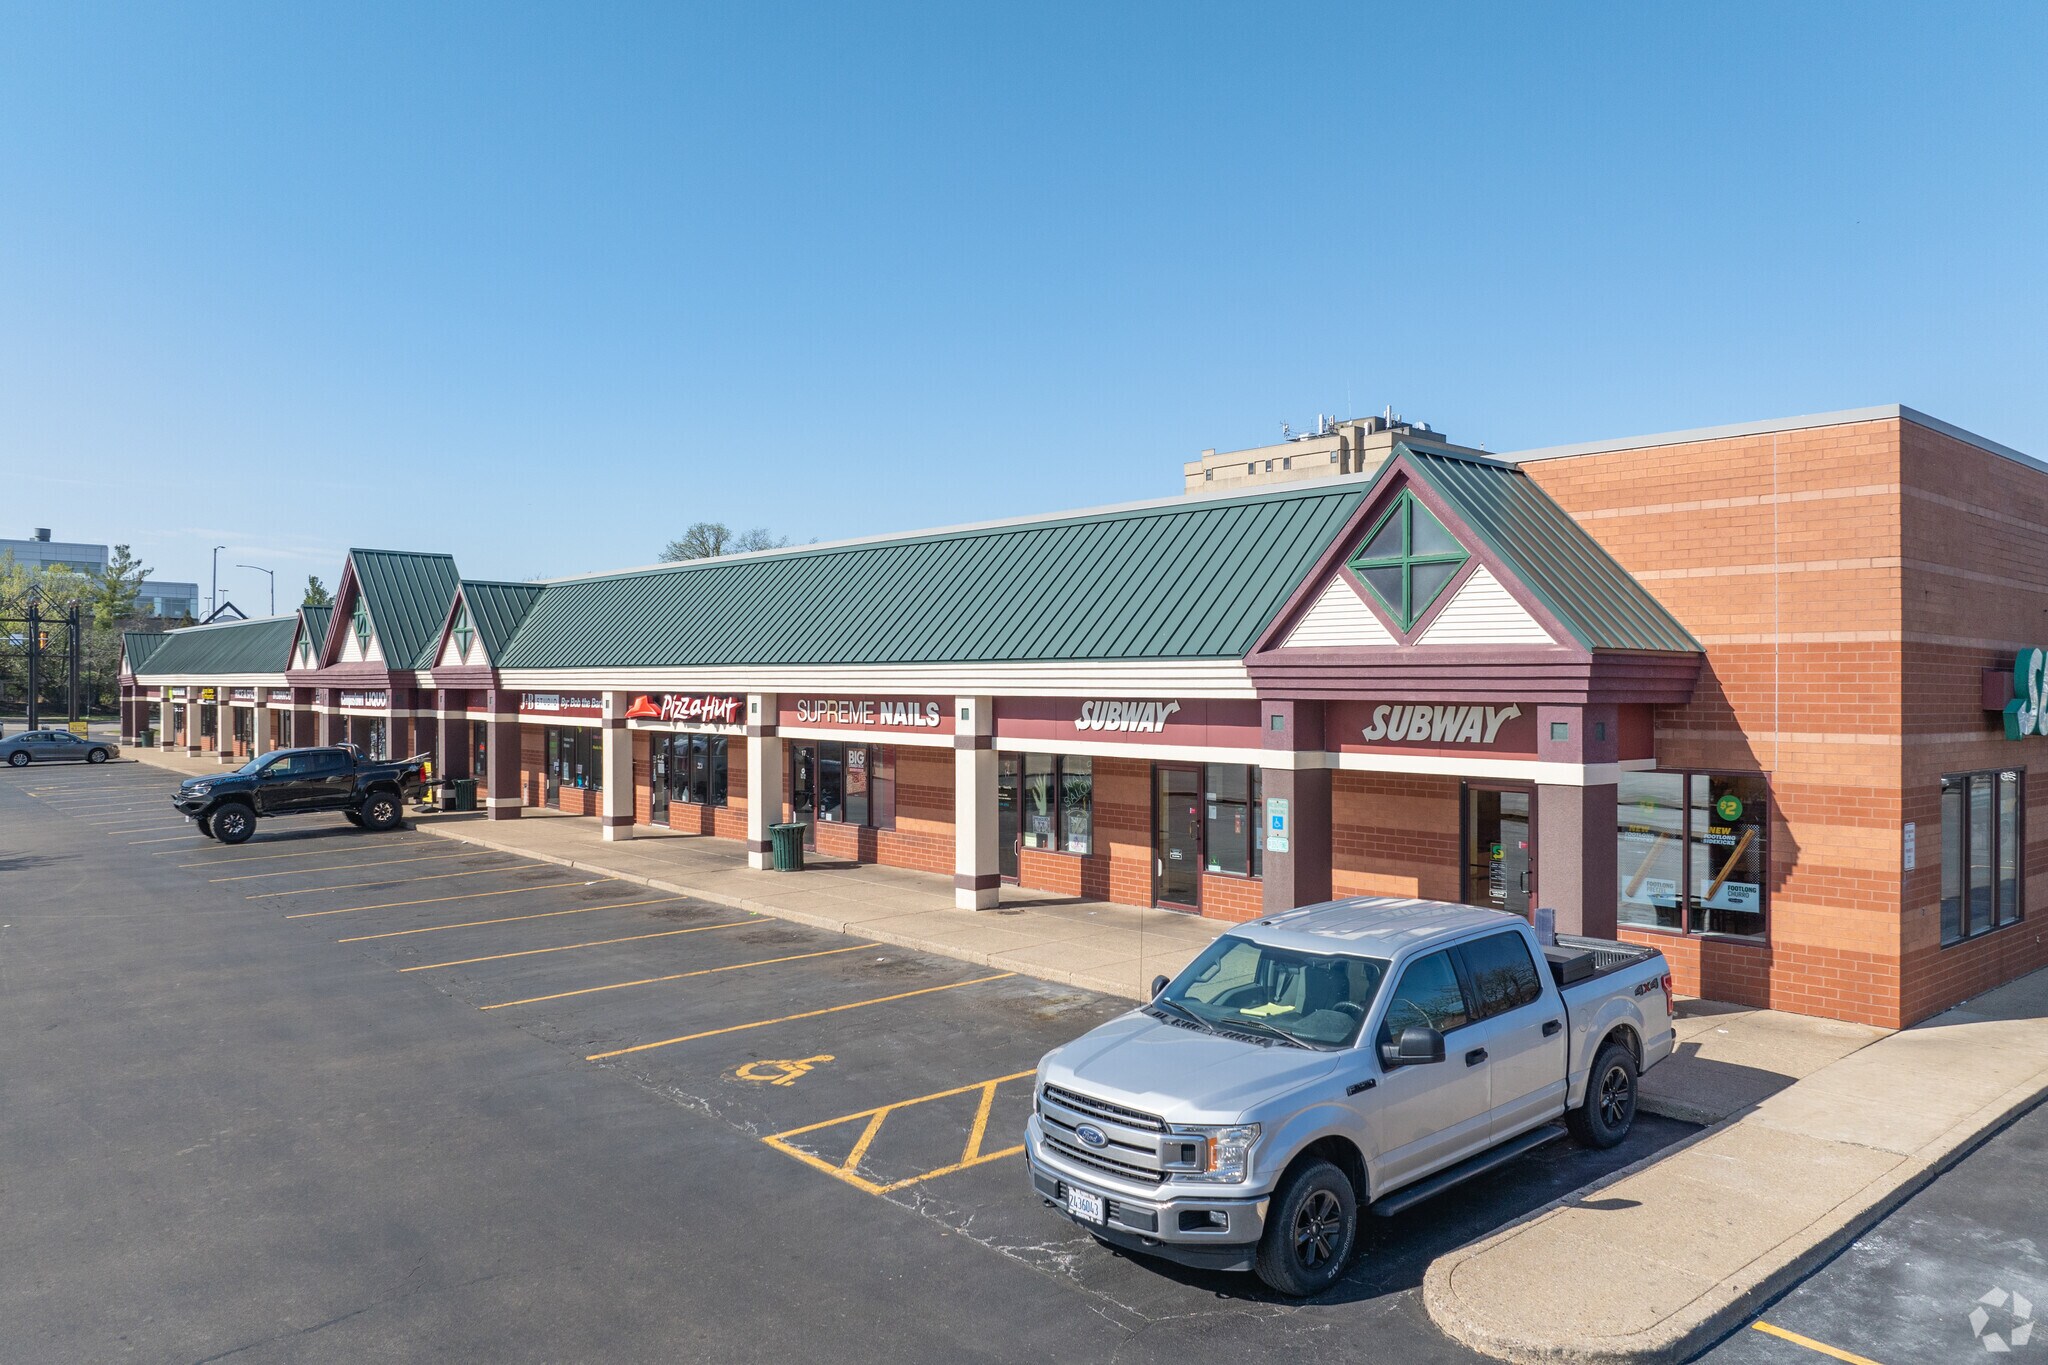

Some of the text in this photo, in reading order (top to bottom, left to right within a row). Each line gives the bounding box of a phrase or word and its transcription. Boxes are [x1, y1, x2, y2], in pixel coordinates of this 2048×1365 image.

[365, 692, 387, 707] LIQUO
[570, 697, 581, 707] Bob
[581, 698, 591, 708] the
[660, 694, 739, 722] Pizza Hut
[797, 699, 941, 727] SUPREME NAILS
[1074, 699, 1180, 733] SUBWAY
[1362, 702, 1521, 743] SUBWAY
[848, 750, 864, 764] BIG
[1720, 801, 1737, 815] $2
[1703, 833, 1736, 841] FOOTLONG
[1708, 826, 1731, 835] NEW
[1646, 881, 1674, 889] FOOTLONG
[1727, 885, 1757, 893] FOOTLONG
[1082, 1130, 1099, 1143] Ford
